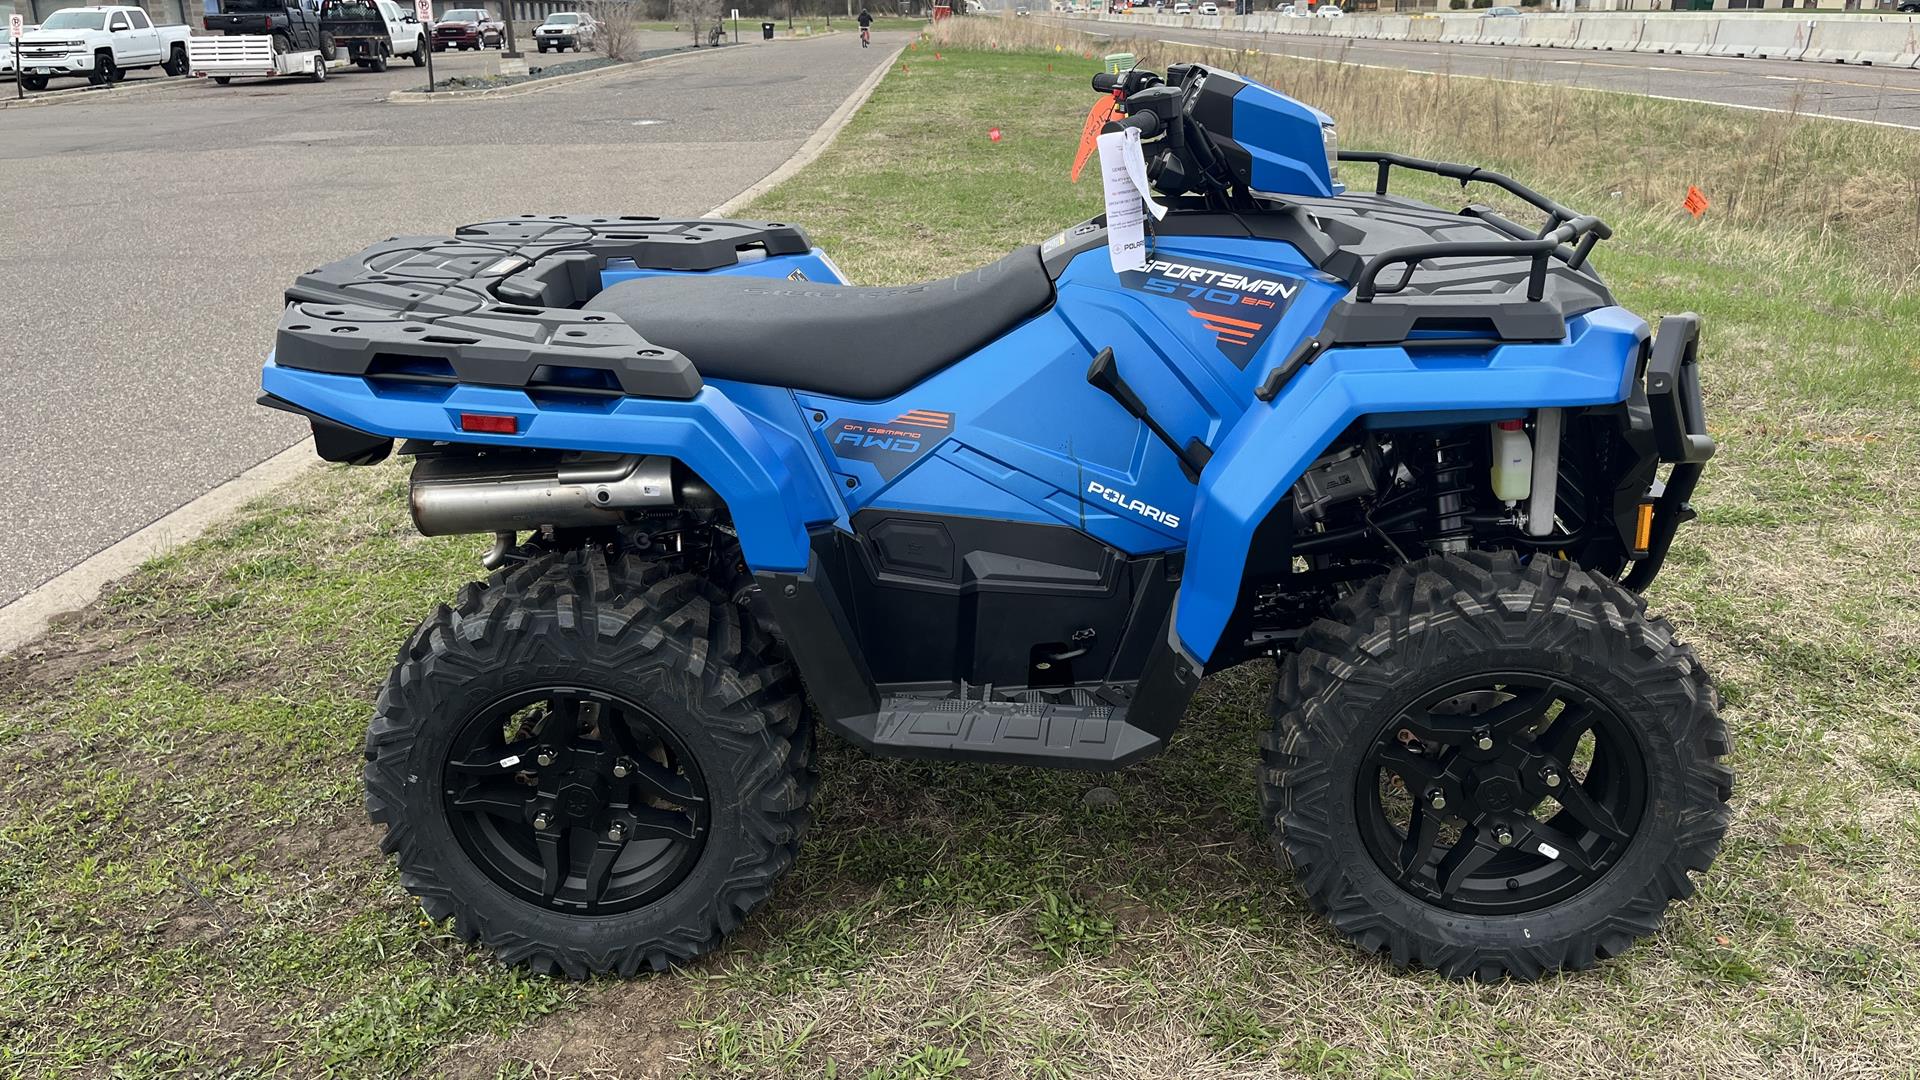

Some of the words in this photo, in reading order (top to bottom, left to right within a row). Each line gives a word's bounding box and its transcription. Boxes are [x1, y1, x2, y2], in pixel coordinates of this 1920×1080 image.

[1133, 259, 1298, 299] SPORTSMAN
[1143, 277, 1240, 306] 570
[1241, 296, 1276, 309] EFI
[834, 432, 921, 453] AWD
[866, 427, 922, 439] DEMAND
[1087, 480, 1181, 529] POLARIS
